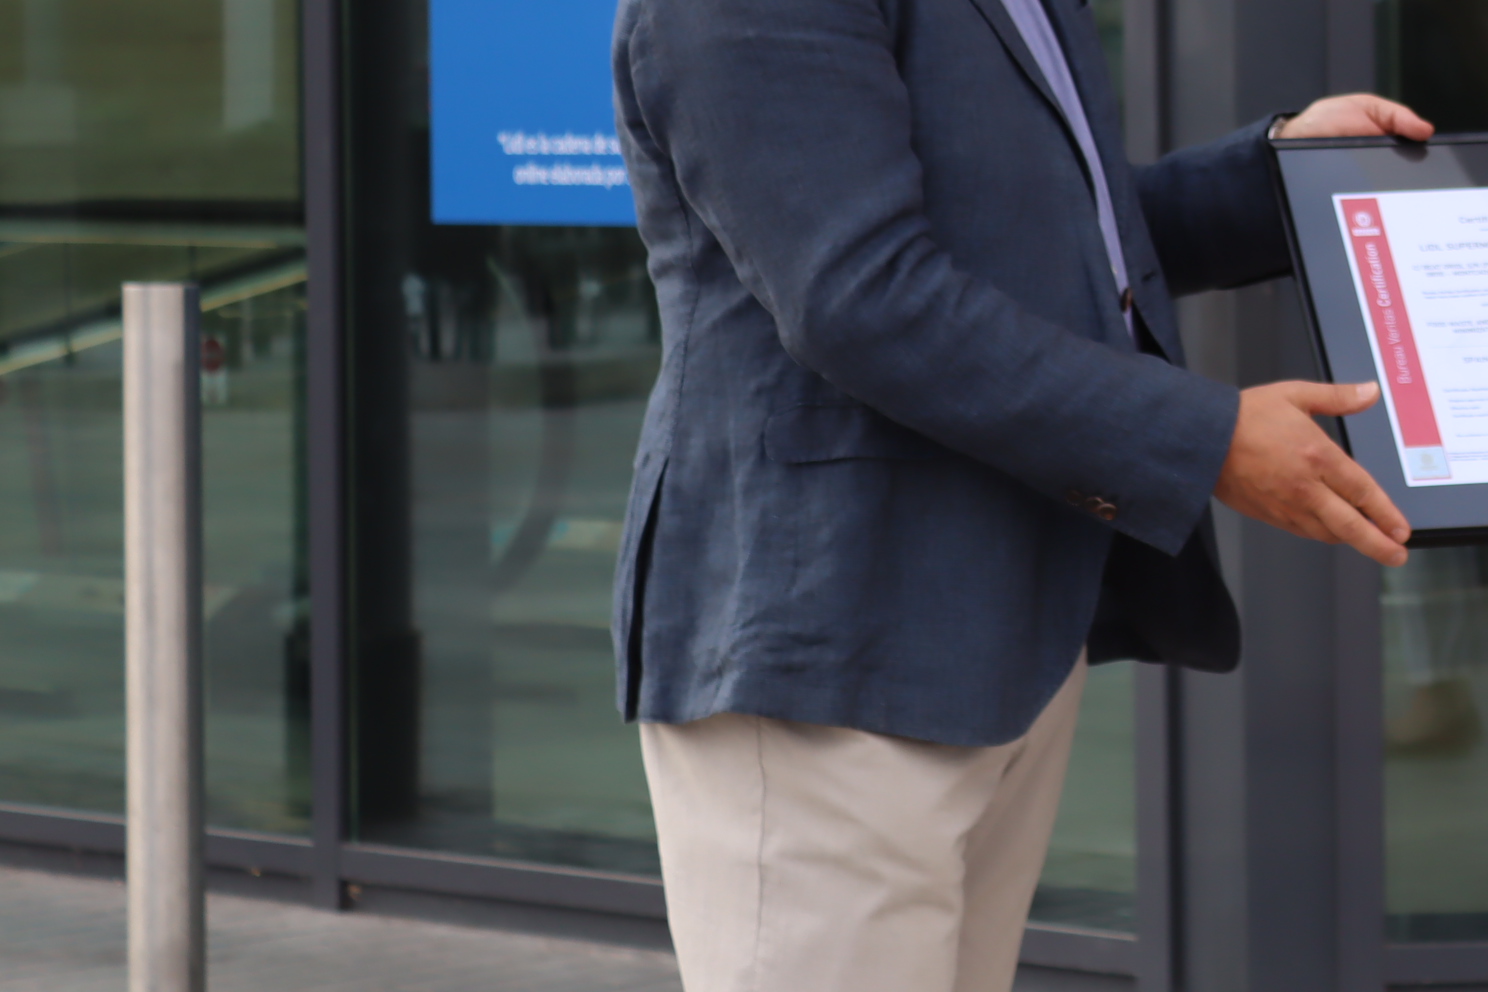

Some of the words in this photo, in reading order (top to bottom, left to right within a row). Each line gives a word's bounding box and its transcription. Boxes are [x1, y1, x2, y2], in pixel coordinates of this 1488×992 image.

[1364, 242, 1392, 307] Certification
[1382, 308, 1402, 345] Veritas
[1394, 346, 1412, 384] Bureau
